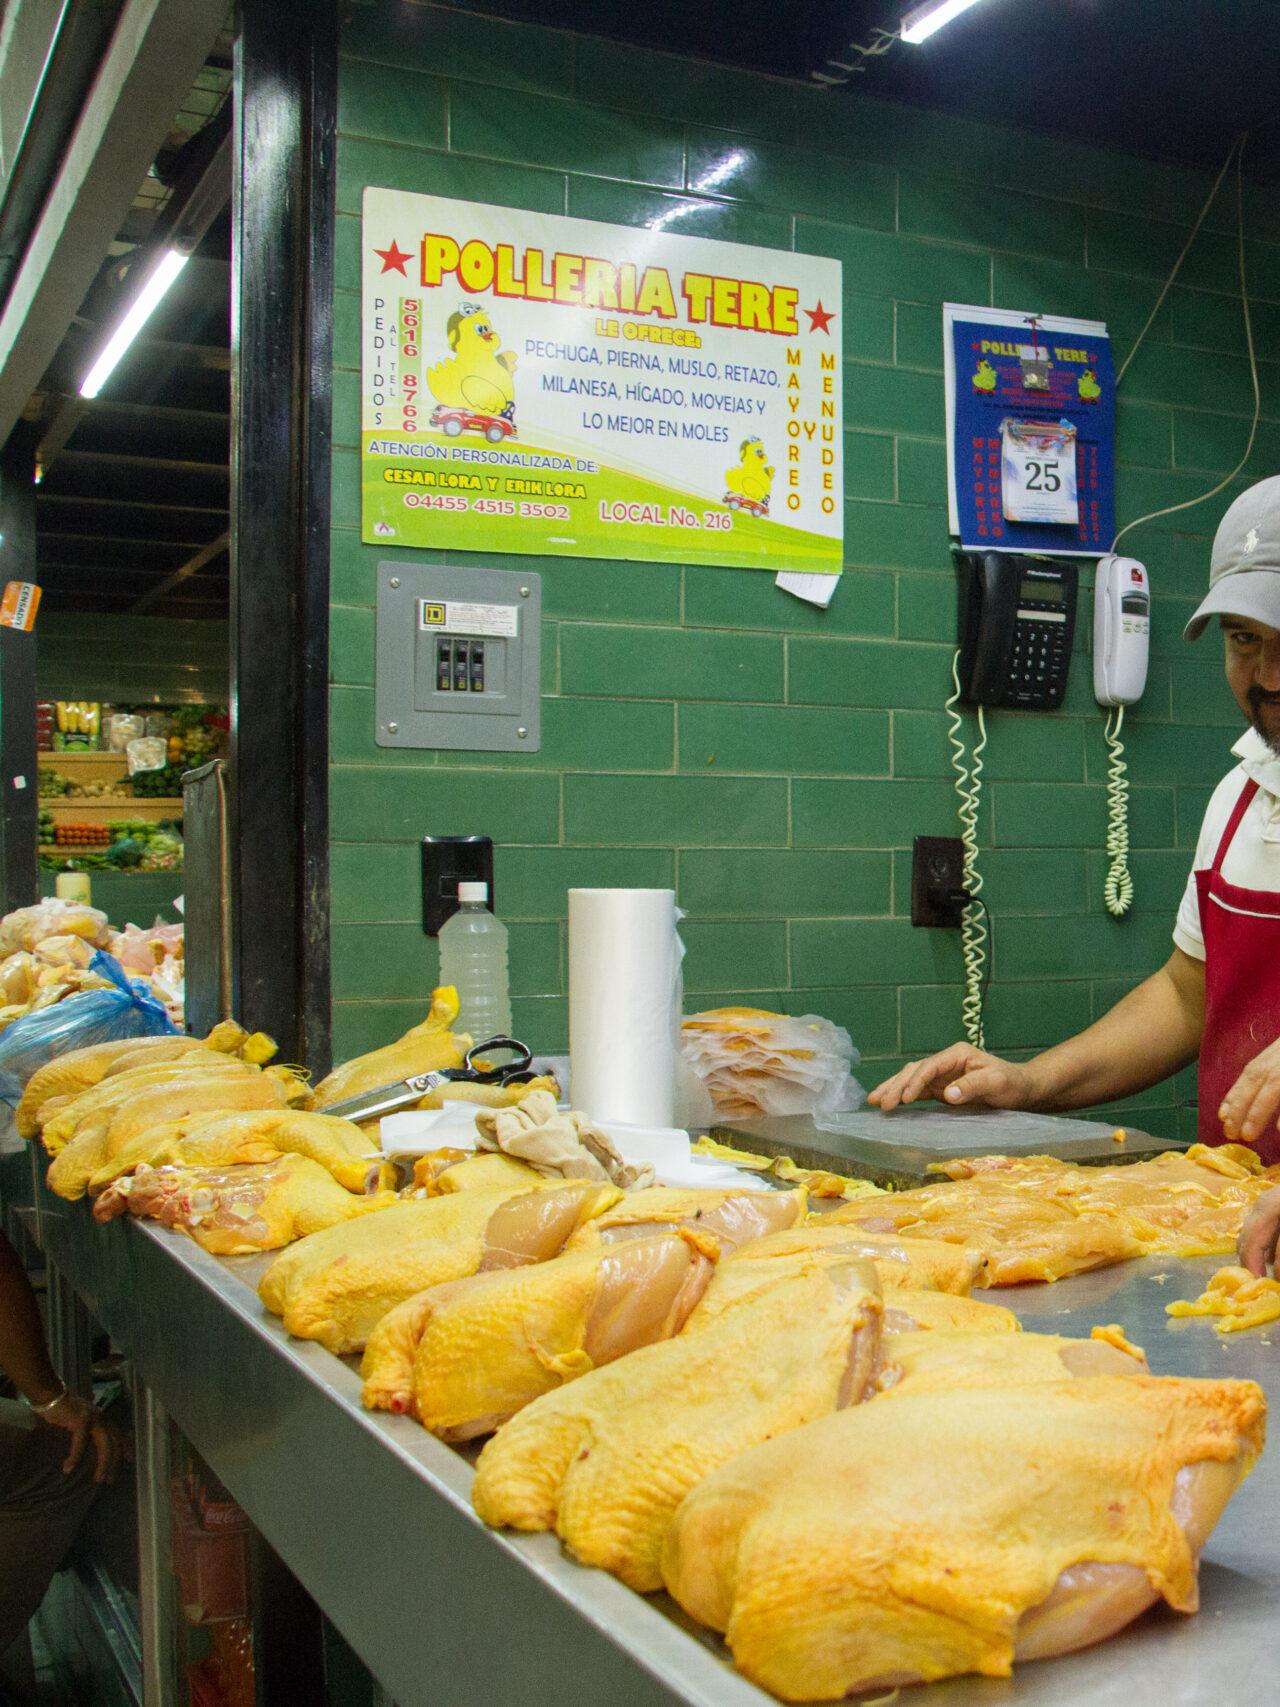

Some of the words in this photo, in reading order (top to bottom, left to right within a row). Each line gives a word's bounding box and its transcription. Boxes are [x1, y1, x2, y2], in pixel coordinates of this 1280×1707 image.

[421, 233, 677, 320] POLLERIA
[682, 272, 799, 336] TERE
[389, 325, 397, 347] AL
[403, 299, 418, 357] 5616
[595, 318, 619, 338] LE
[623, 322, 702, 348] OFRECE:
[373, 298, 385, 425] PEDIDOS
[525, 339, 603, 366] PECHUGA,
[607, 350, 665, 375] PIERNA,
[668, 357, 721, 380] MUSLO,
[724, 365, 781, 388] RETAZO,
[1054, 347, 1089, 363] TERE
[389, 362, 397, 397] TEL
[542, 375, 622, 400] MILANESA,
[625, 383, 688, 408] HÍGADO,
[691, 392, 753, 415] MOYEJAS
[756, 401, 766, 416] Y
[402, 374, 418, 432] 8766
[583, 412, 602, 430] LO
[607, 415, 654, 436] MEJOR
[658, 420, 678, 438] EN
[682, 425, 729, 443] MOLES
[787, 348, 800, 510] MAYOREO
[804, 421, 816, 440] Y
[821, 352, 835, 514] MENUDEO
[369, 440, 448, 460] ATENCIÓN
[452, 448, 572, 470] PERSONALIZADA
[576, 460, 599, 472] DE:
[383, 467, 436, 486] CESAR
[439, 472, 482, 491] LORA
[487, 476, 499, 491] Y
[506, 478, 543, 495] ERIK
[546, 481, 587, 499] LORA
[1025, 461, 1061, 492] 25
[405, 493, 467, 511] 04455
[474, 498, 515, 515] 4515
[521, 503, 569, 519] 3502
[600, 502, 665, 525] LOCAL
[670, 508, 700, 528] No.
[705, 513, 732, 529] 216
